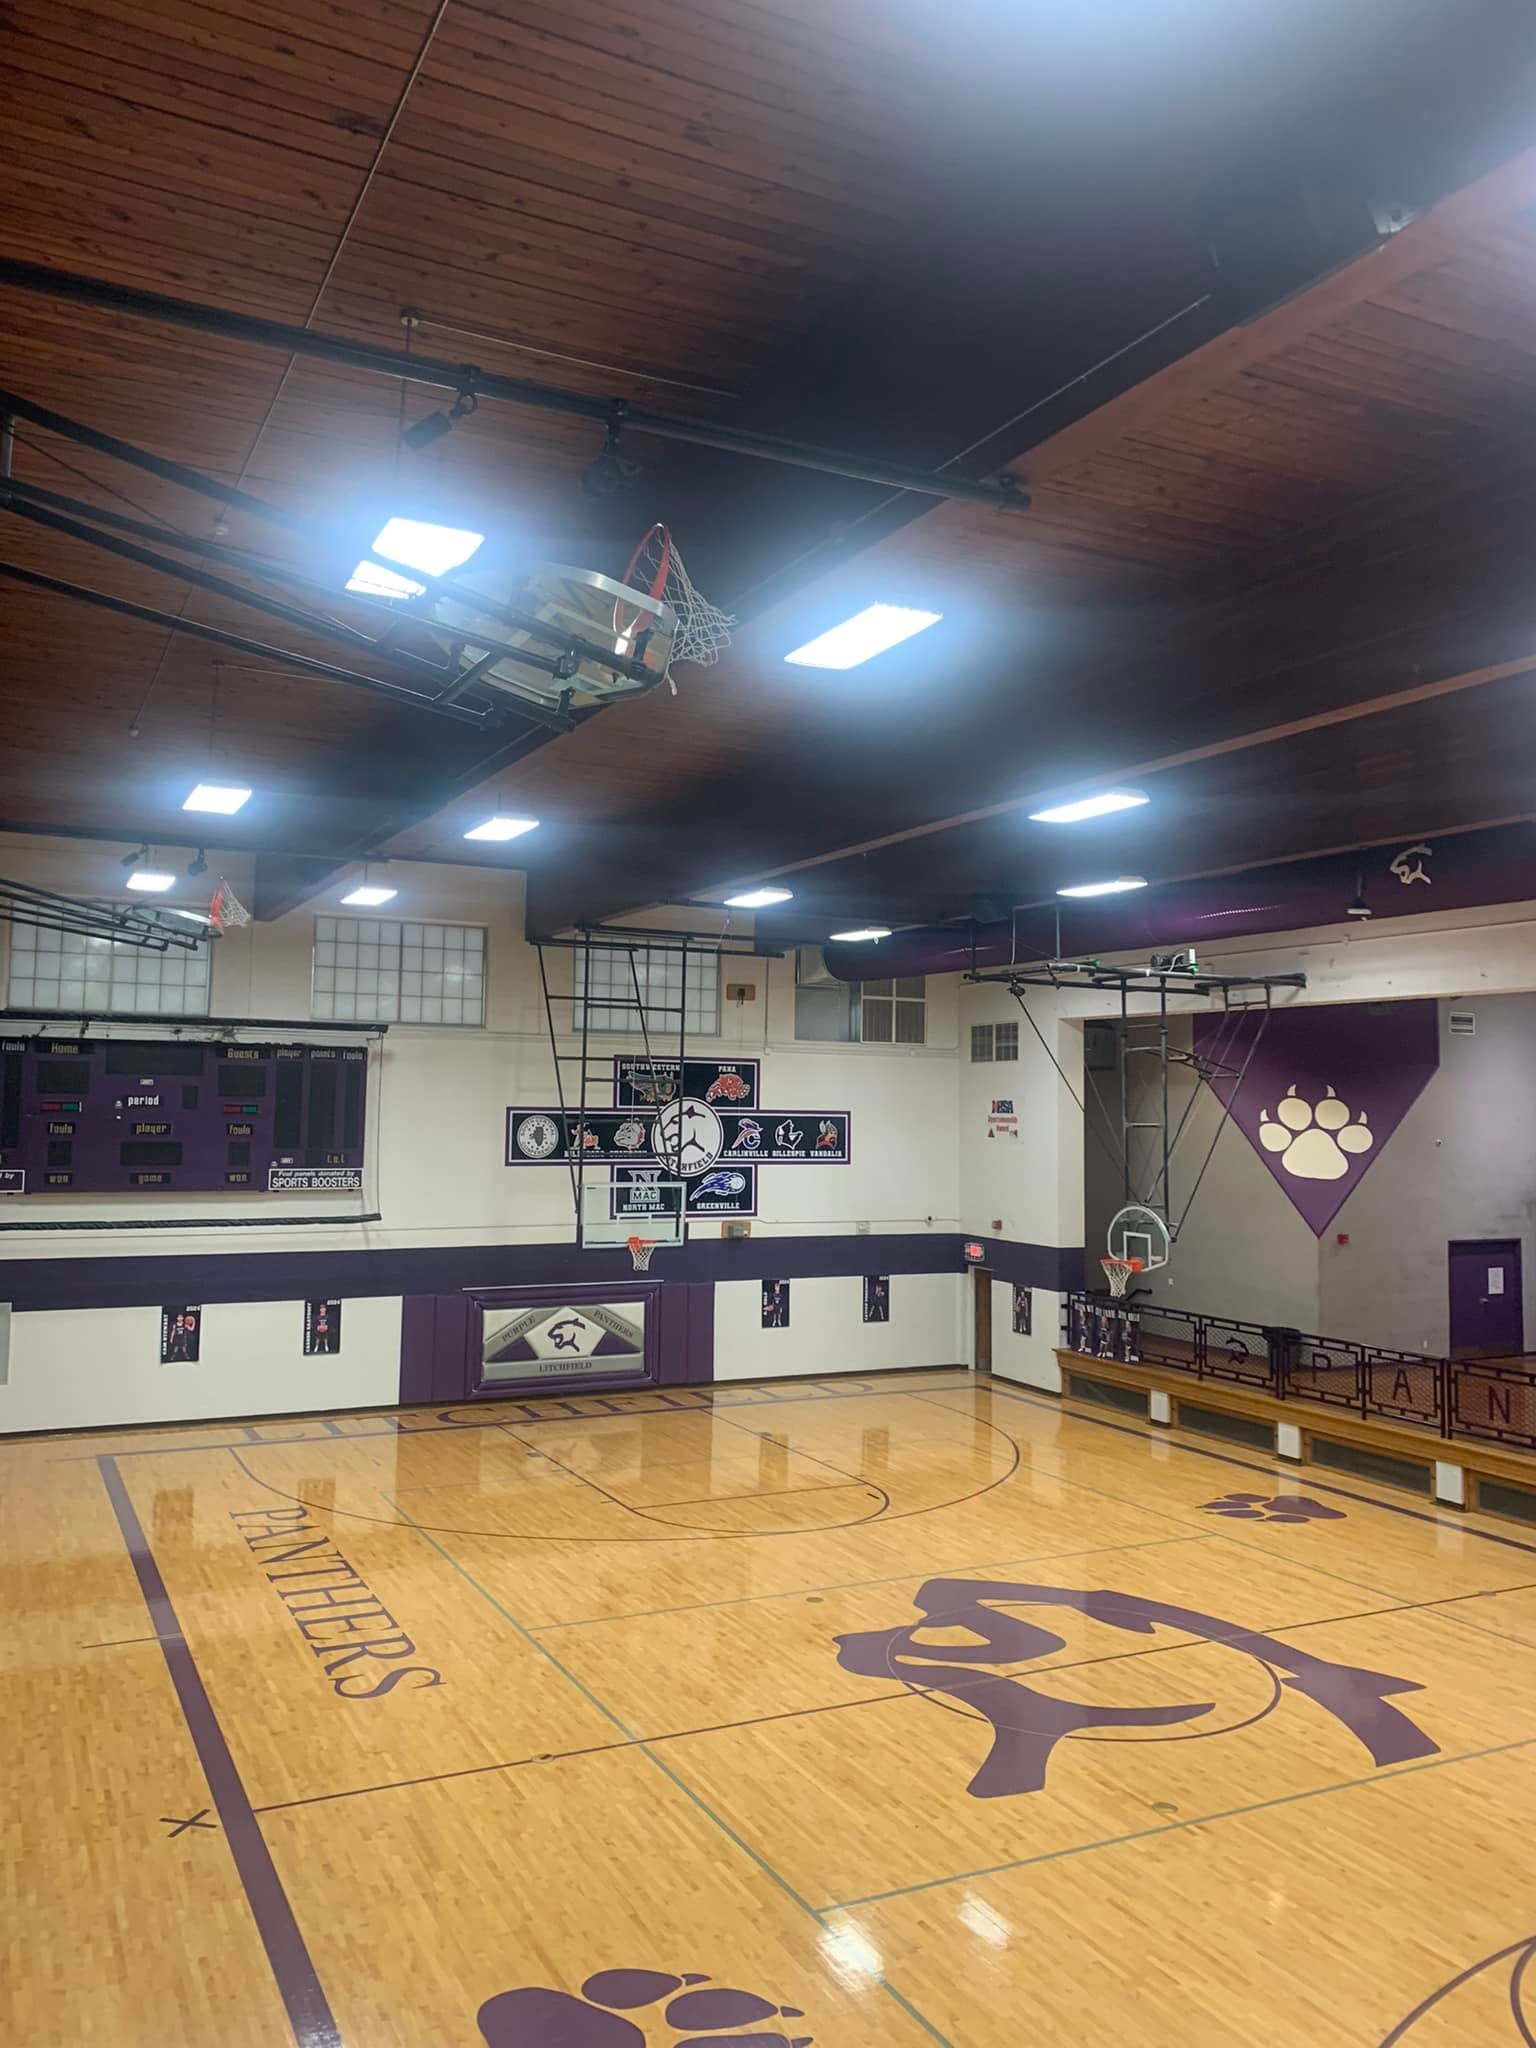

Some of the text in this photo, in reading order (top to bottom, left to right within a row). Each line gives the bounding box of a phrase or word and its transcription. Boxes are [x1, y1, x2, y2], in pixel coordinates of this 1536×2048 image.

[51, 1042, 78, 1054] Home
[128, 1095, 159, 1107] period
[136, 1123, 167, 1134] player
[272, 1177, 360, 1187] SPORTS BOOSTERS
[632, 1191, 657, 1199] MAC
[623, 1203, 647, 1211] NORTH
[502, 1315, 536, 1342] PURPLE
[592, 1309, 634, 1339] PANTHERS
[538, 1361, 592, 1373] LITCHFIELD
[229, 1503, 447, 1699] PANTHERS
